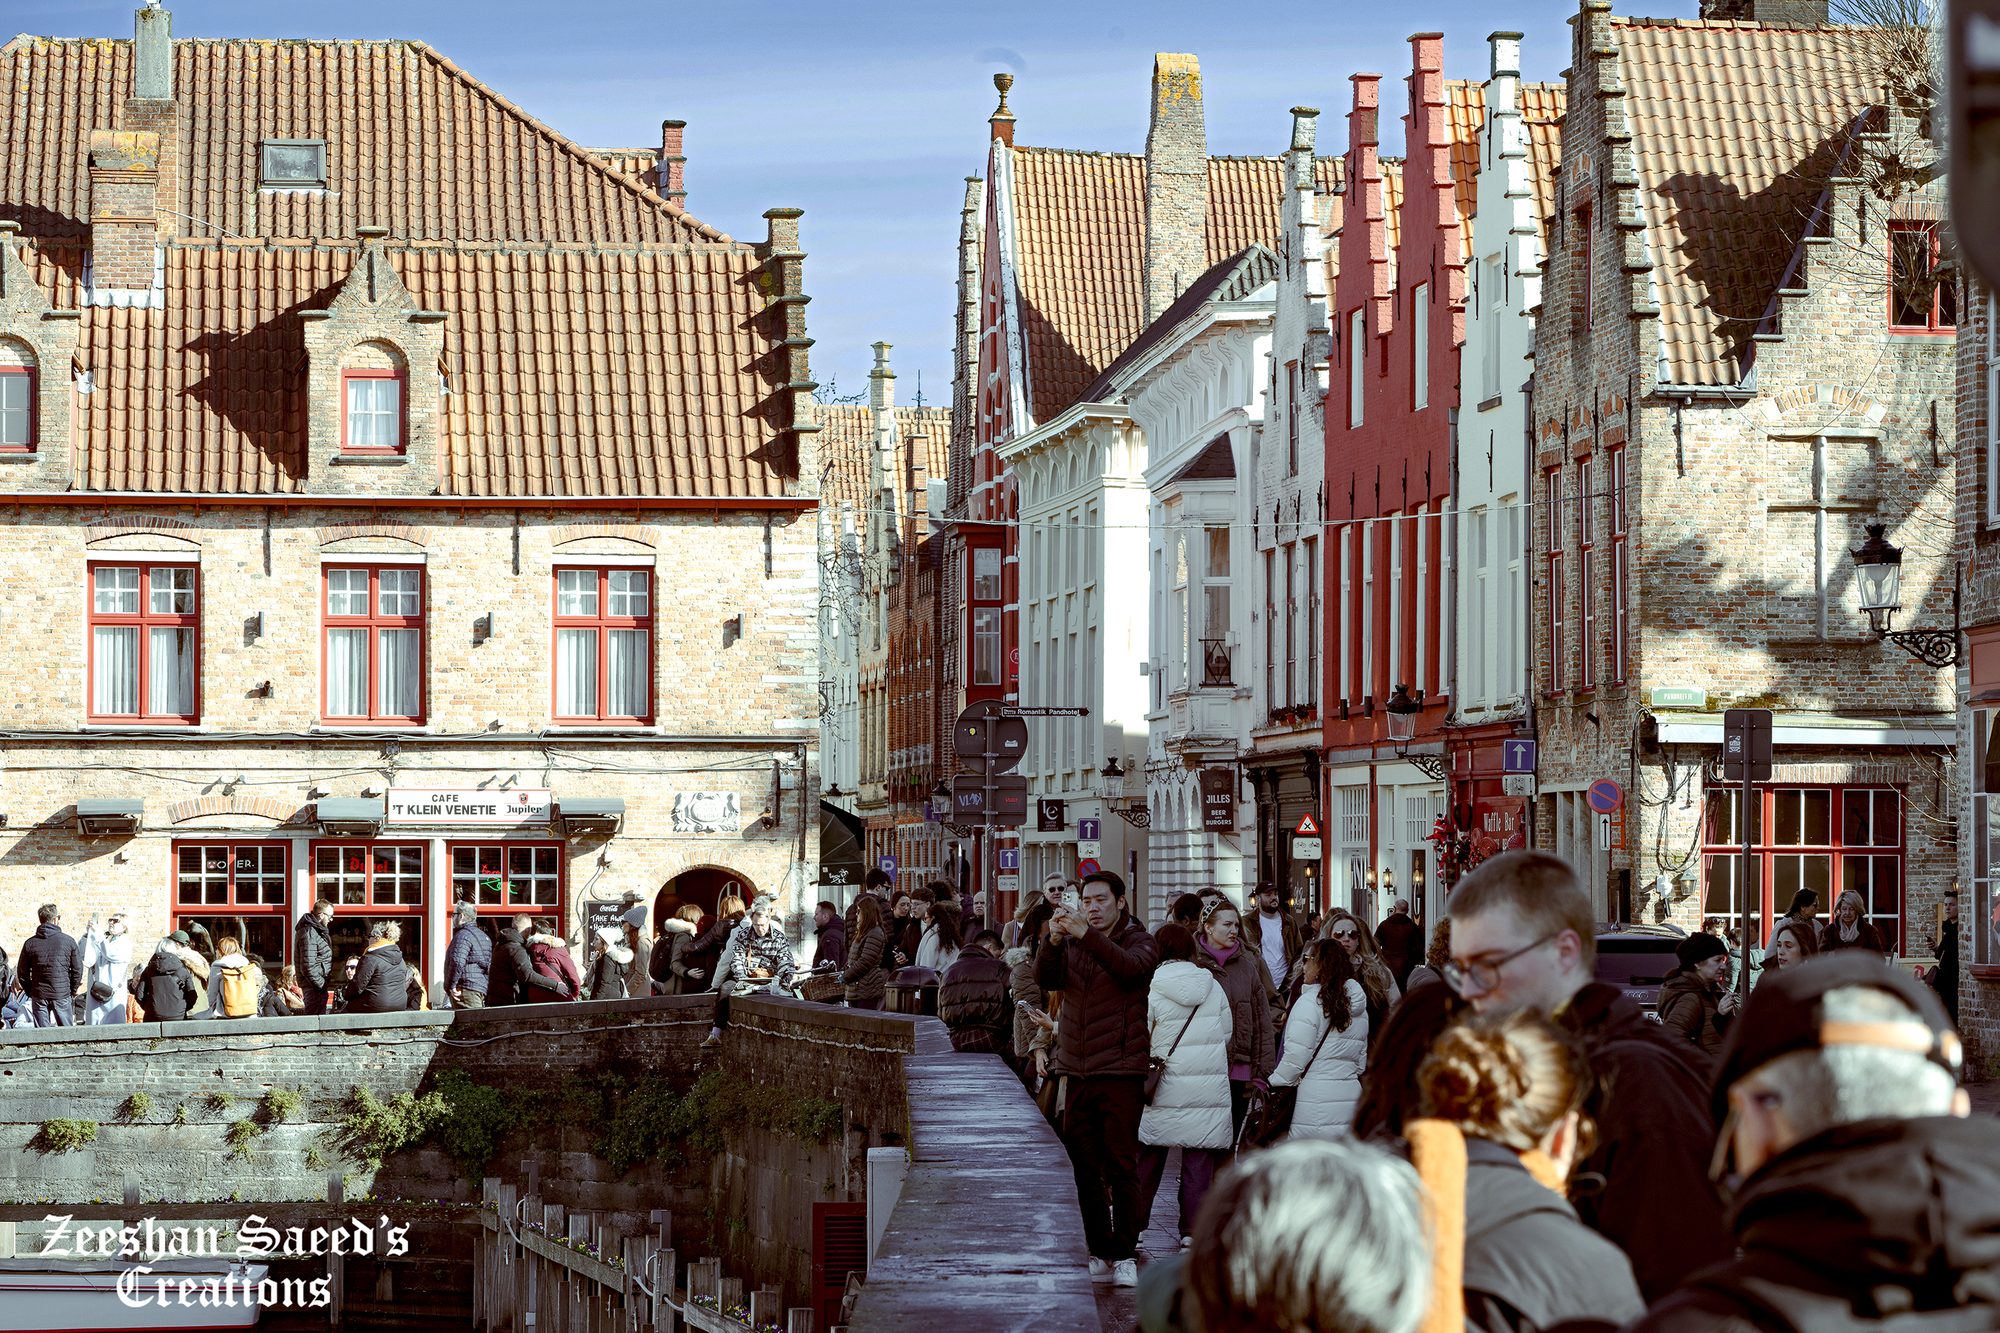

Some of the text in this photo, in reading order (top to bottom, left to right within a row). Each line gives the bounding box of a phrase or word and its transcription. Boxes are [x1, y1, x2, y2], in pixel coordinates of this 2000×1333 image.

[976, 551, 998, 561] ART
[1017, 708, 1046, 716] Romantik
[1049, 708, 1080, 716] Pandhotel
[432, 794, 459, 803] CAFE
[1205, 794, 1231, 804] JILLES
[392, 804, 497, 815] 'T KLEIN VENETIE
[506, 804, 543, 815] Jupiler
[1483, 811, 1515, 832] Waffle Bar
[350, 856, 389, 874] Duel
[881, 859, 895, 873] P
[589, 914, 625, 922] TAKE AWA
